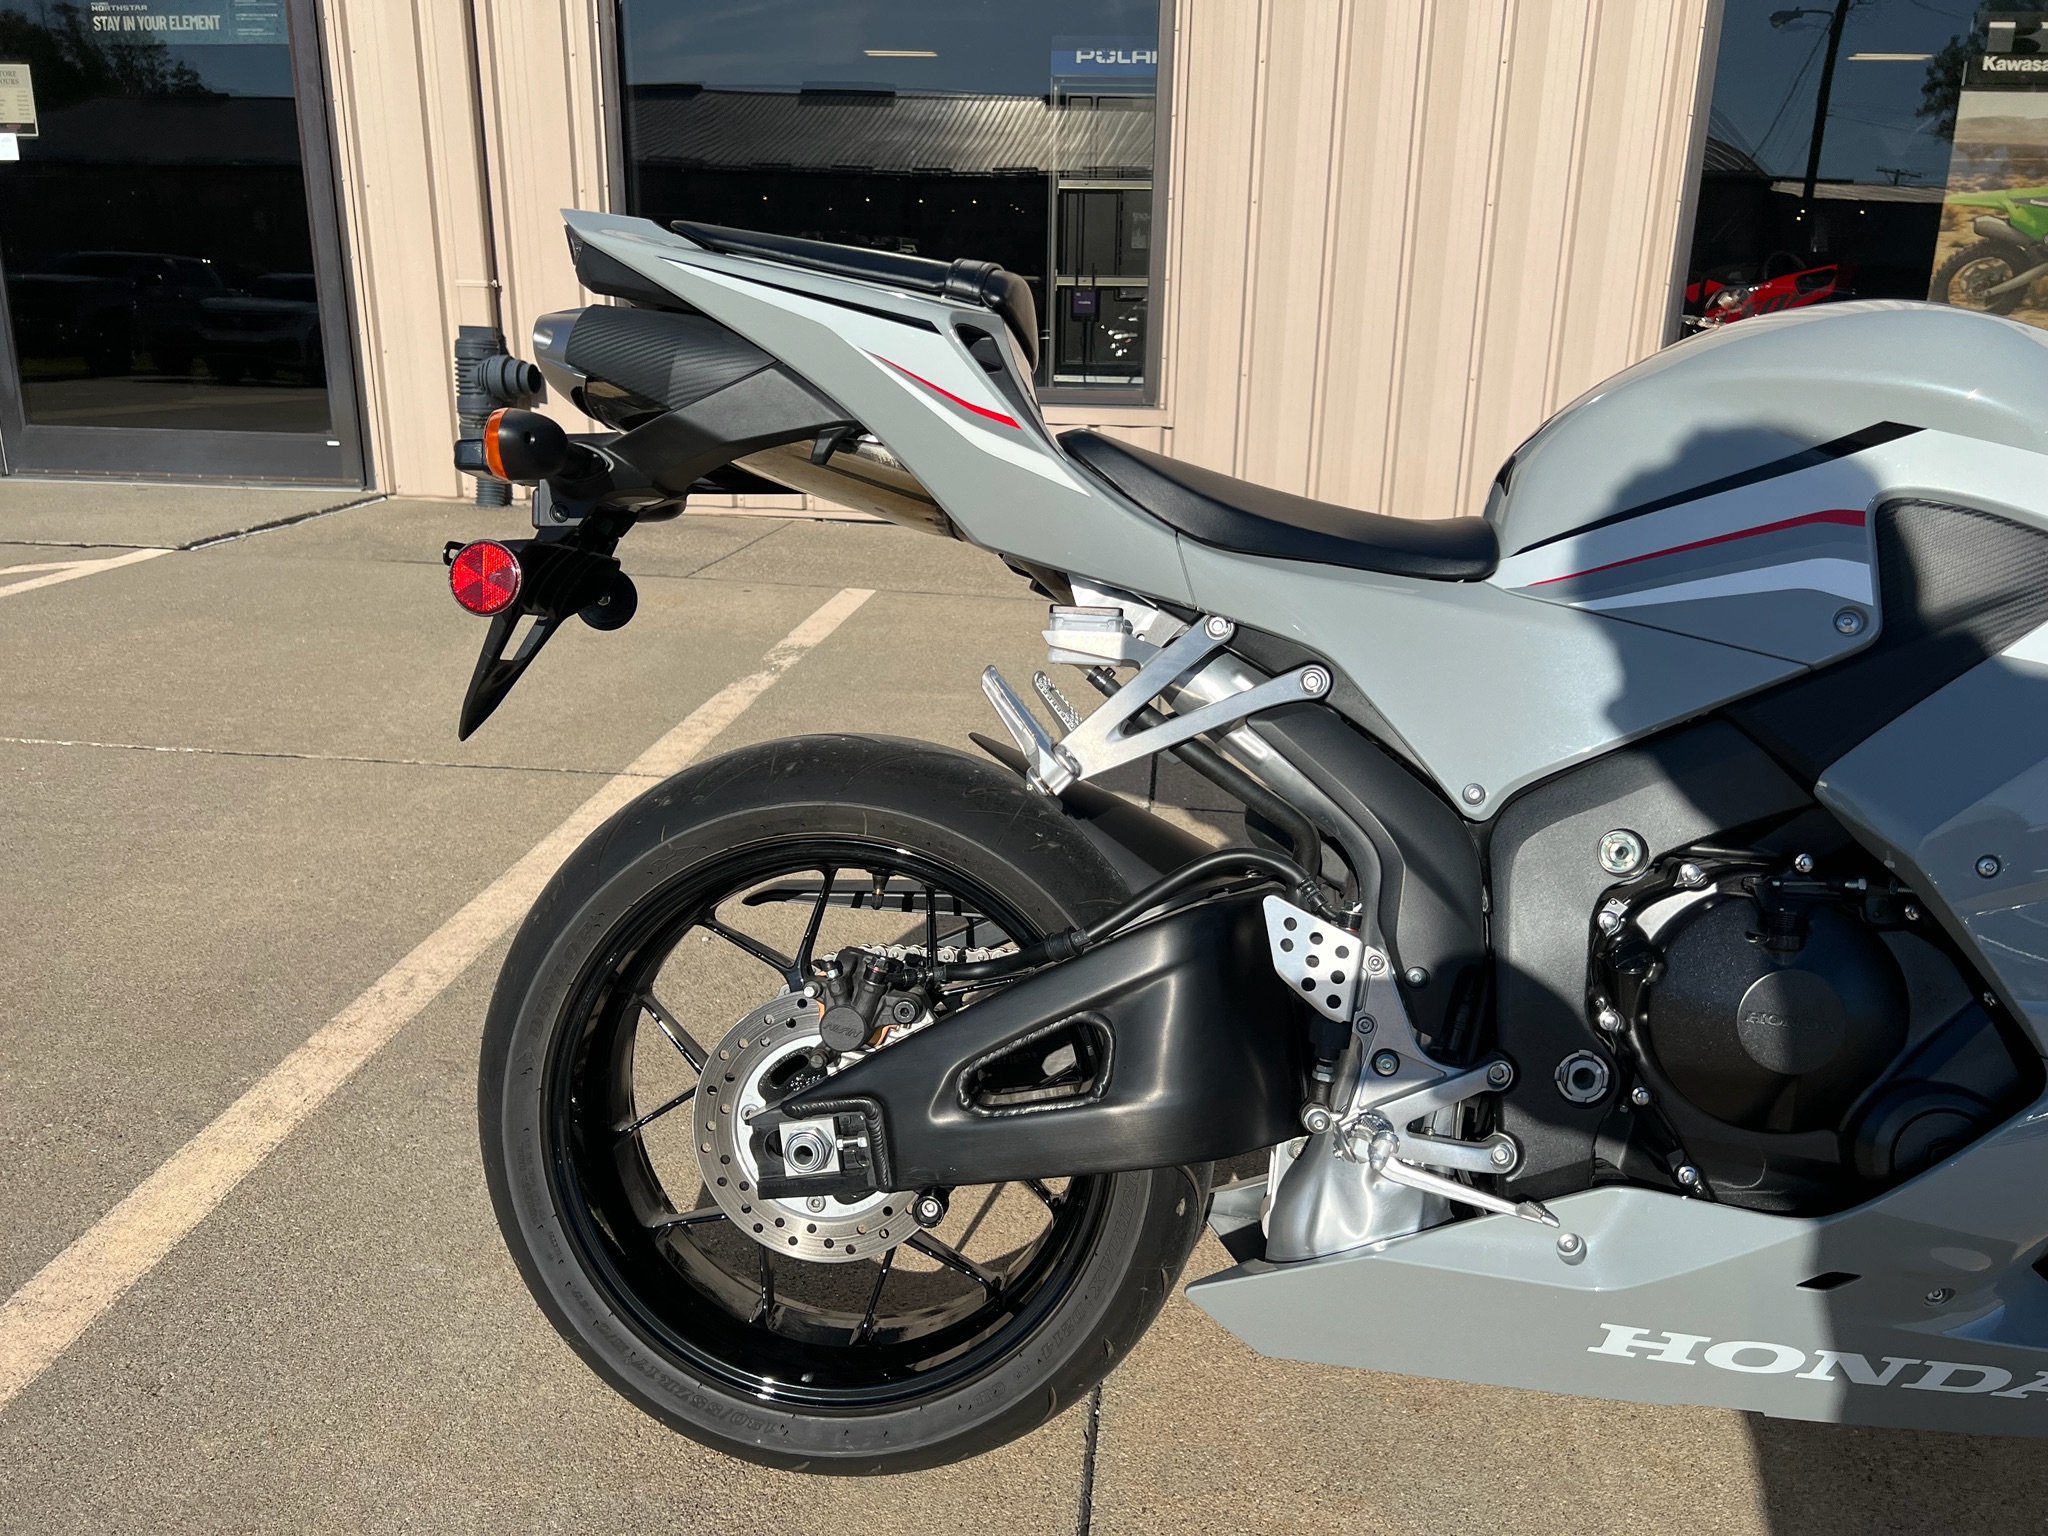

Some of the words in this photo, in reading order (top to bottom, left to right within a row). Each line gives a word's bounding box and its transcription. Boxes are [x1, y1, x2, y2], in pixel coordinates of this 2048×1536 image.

[91, 4, 148, 12] NORTHSTAR
[93, 15, 121, 32] STAY
[123, 15, 136, 31] IN
[137, 15, 168, 31] YOUR
[169, 14, 221, 31] ELEMENT
[1075, 50, 1157, 65] POLA
